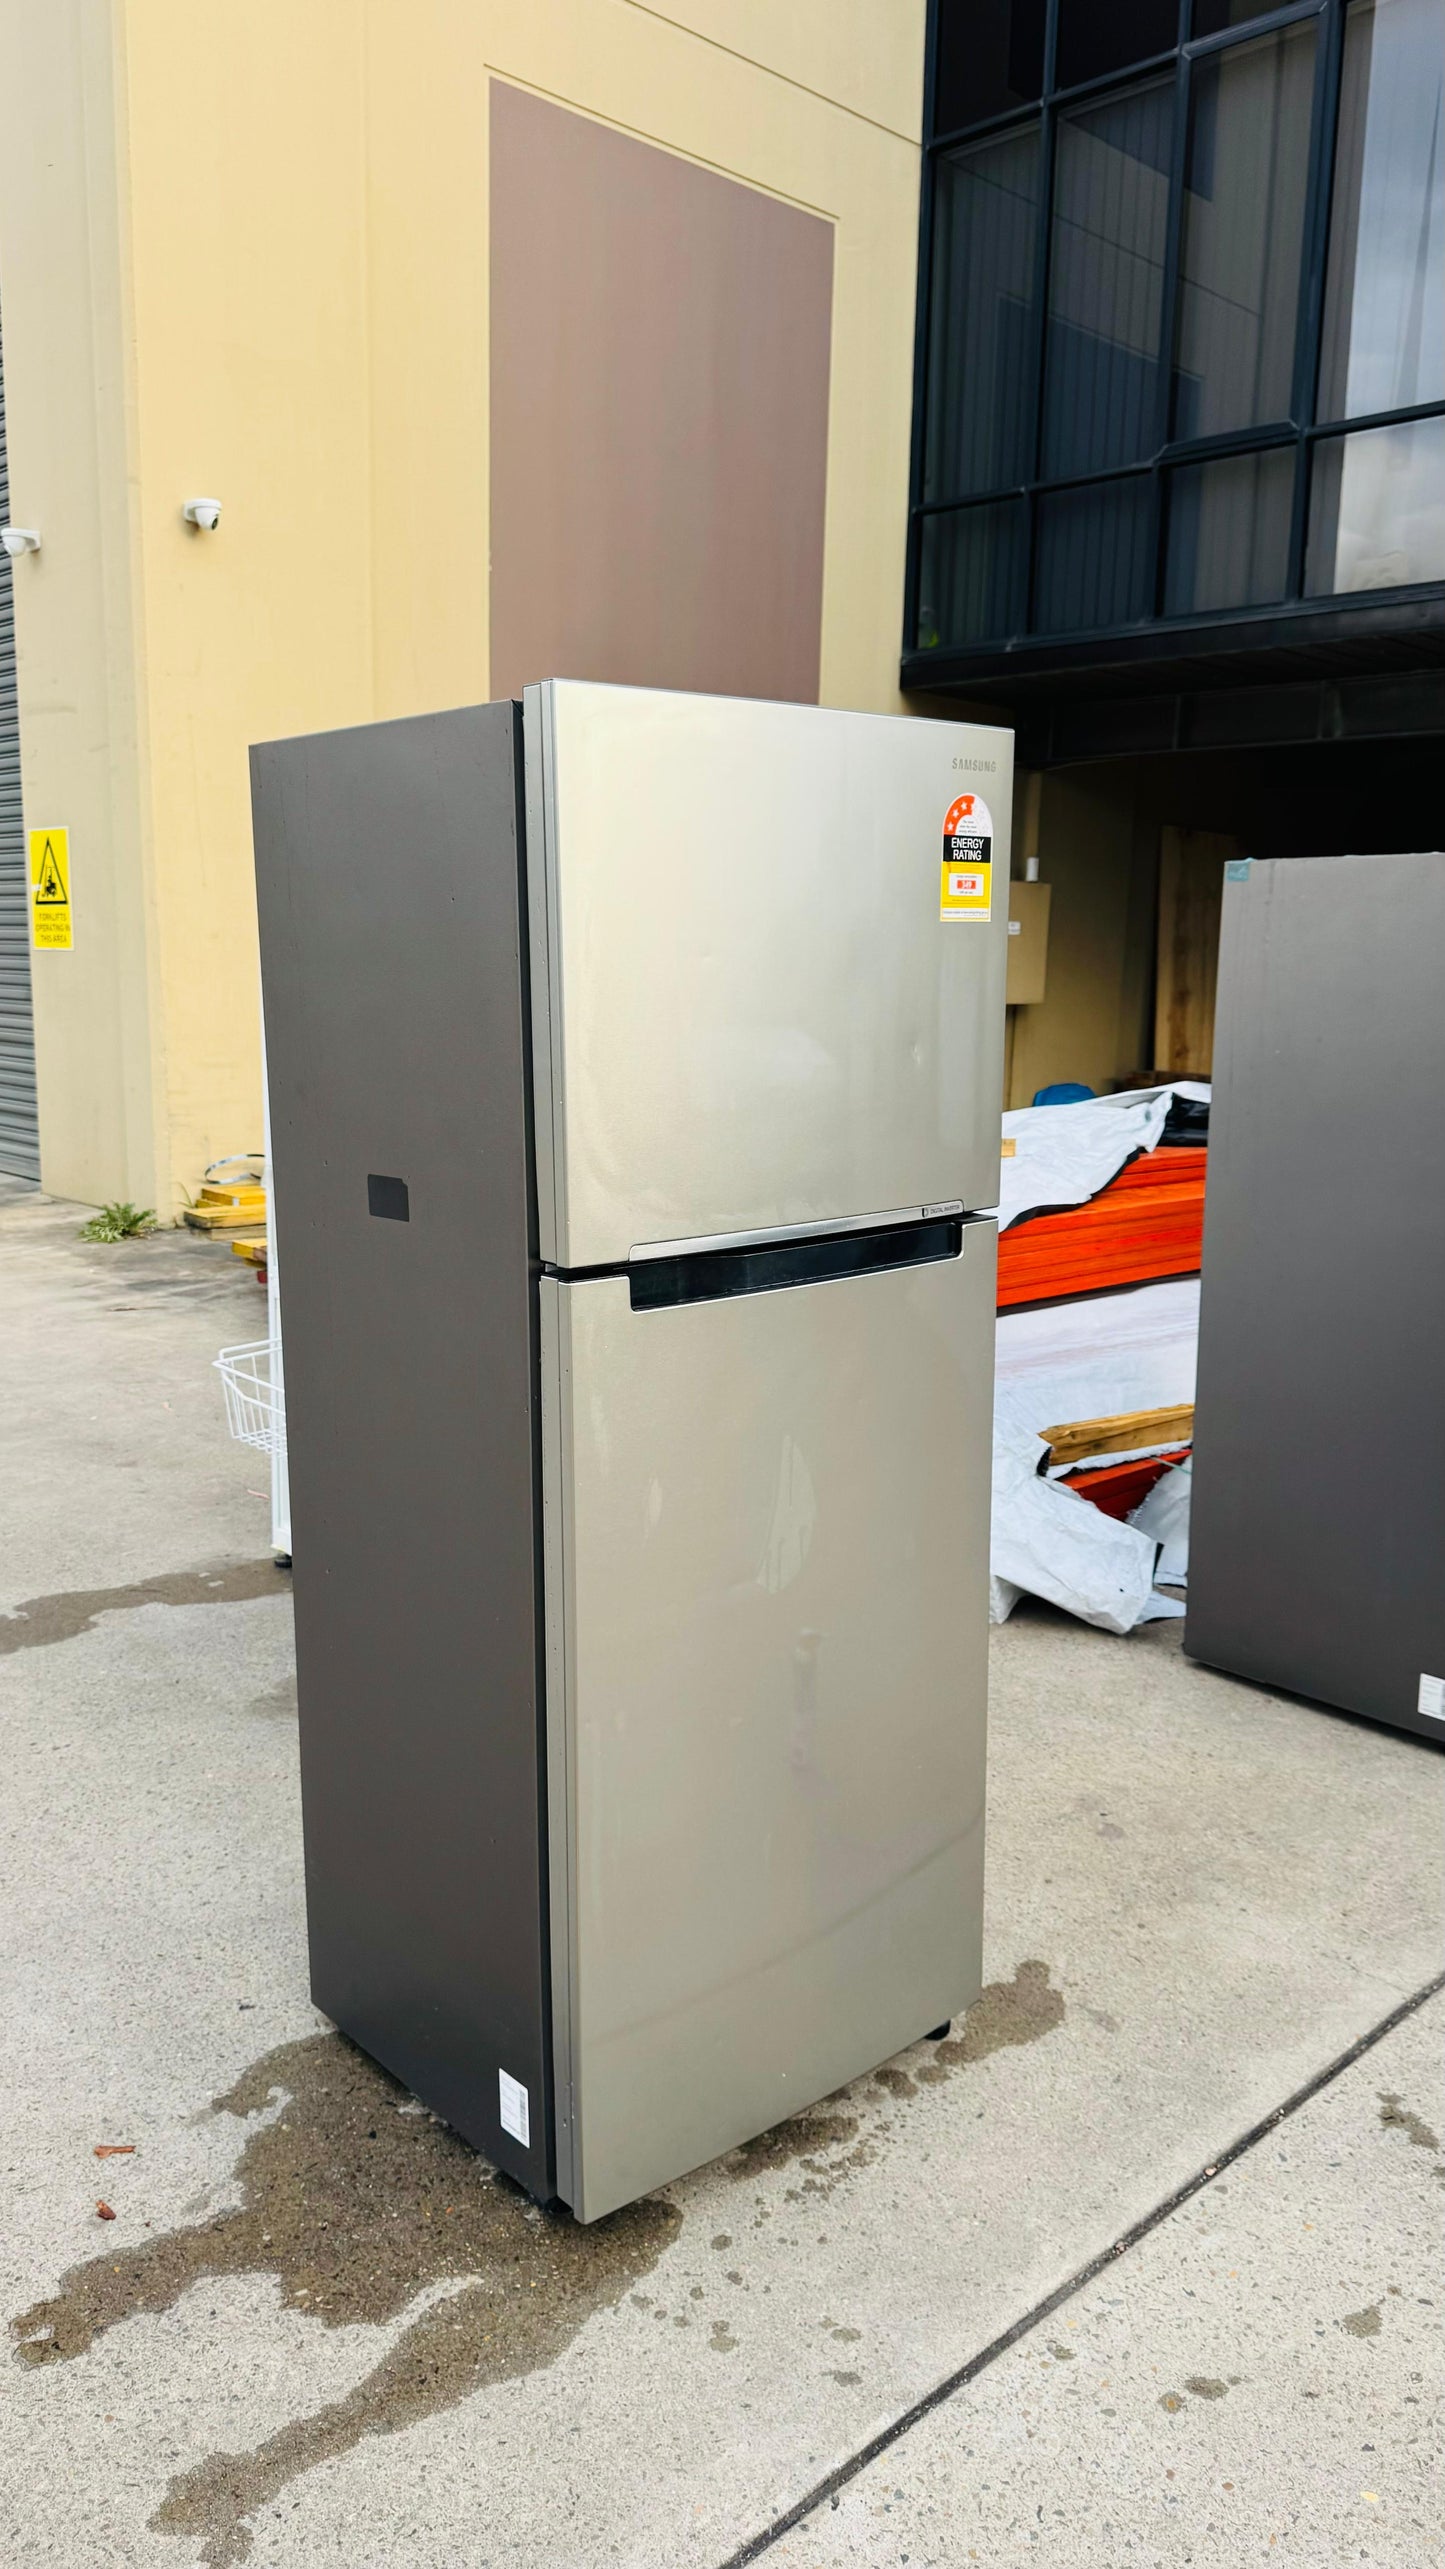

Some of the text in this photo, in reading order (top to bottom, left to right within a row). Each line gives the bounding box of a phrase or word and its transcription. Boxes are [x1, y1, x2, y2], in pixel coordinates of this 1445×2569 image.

[952, 758, 997, 772] SAMSUNG
[951, 837, 984, 849] ENERGY
[952, 849, 982, 861] RATING
